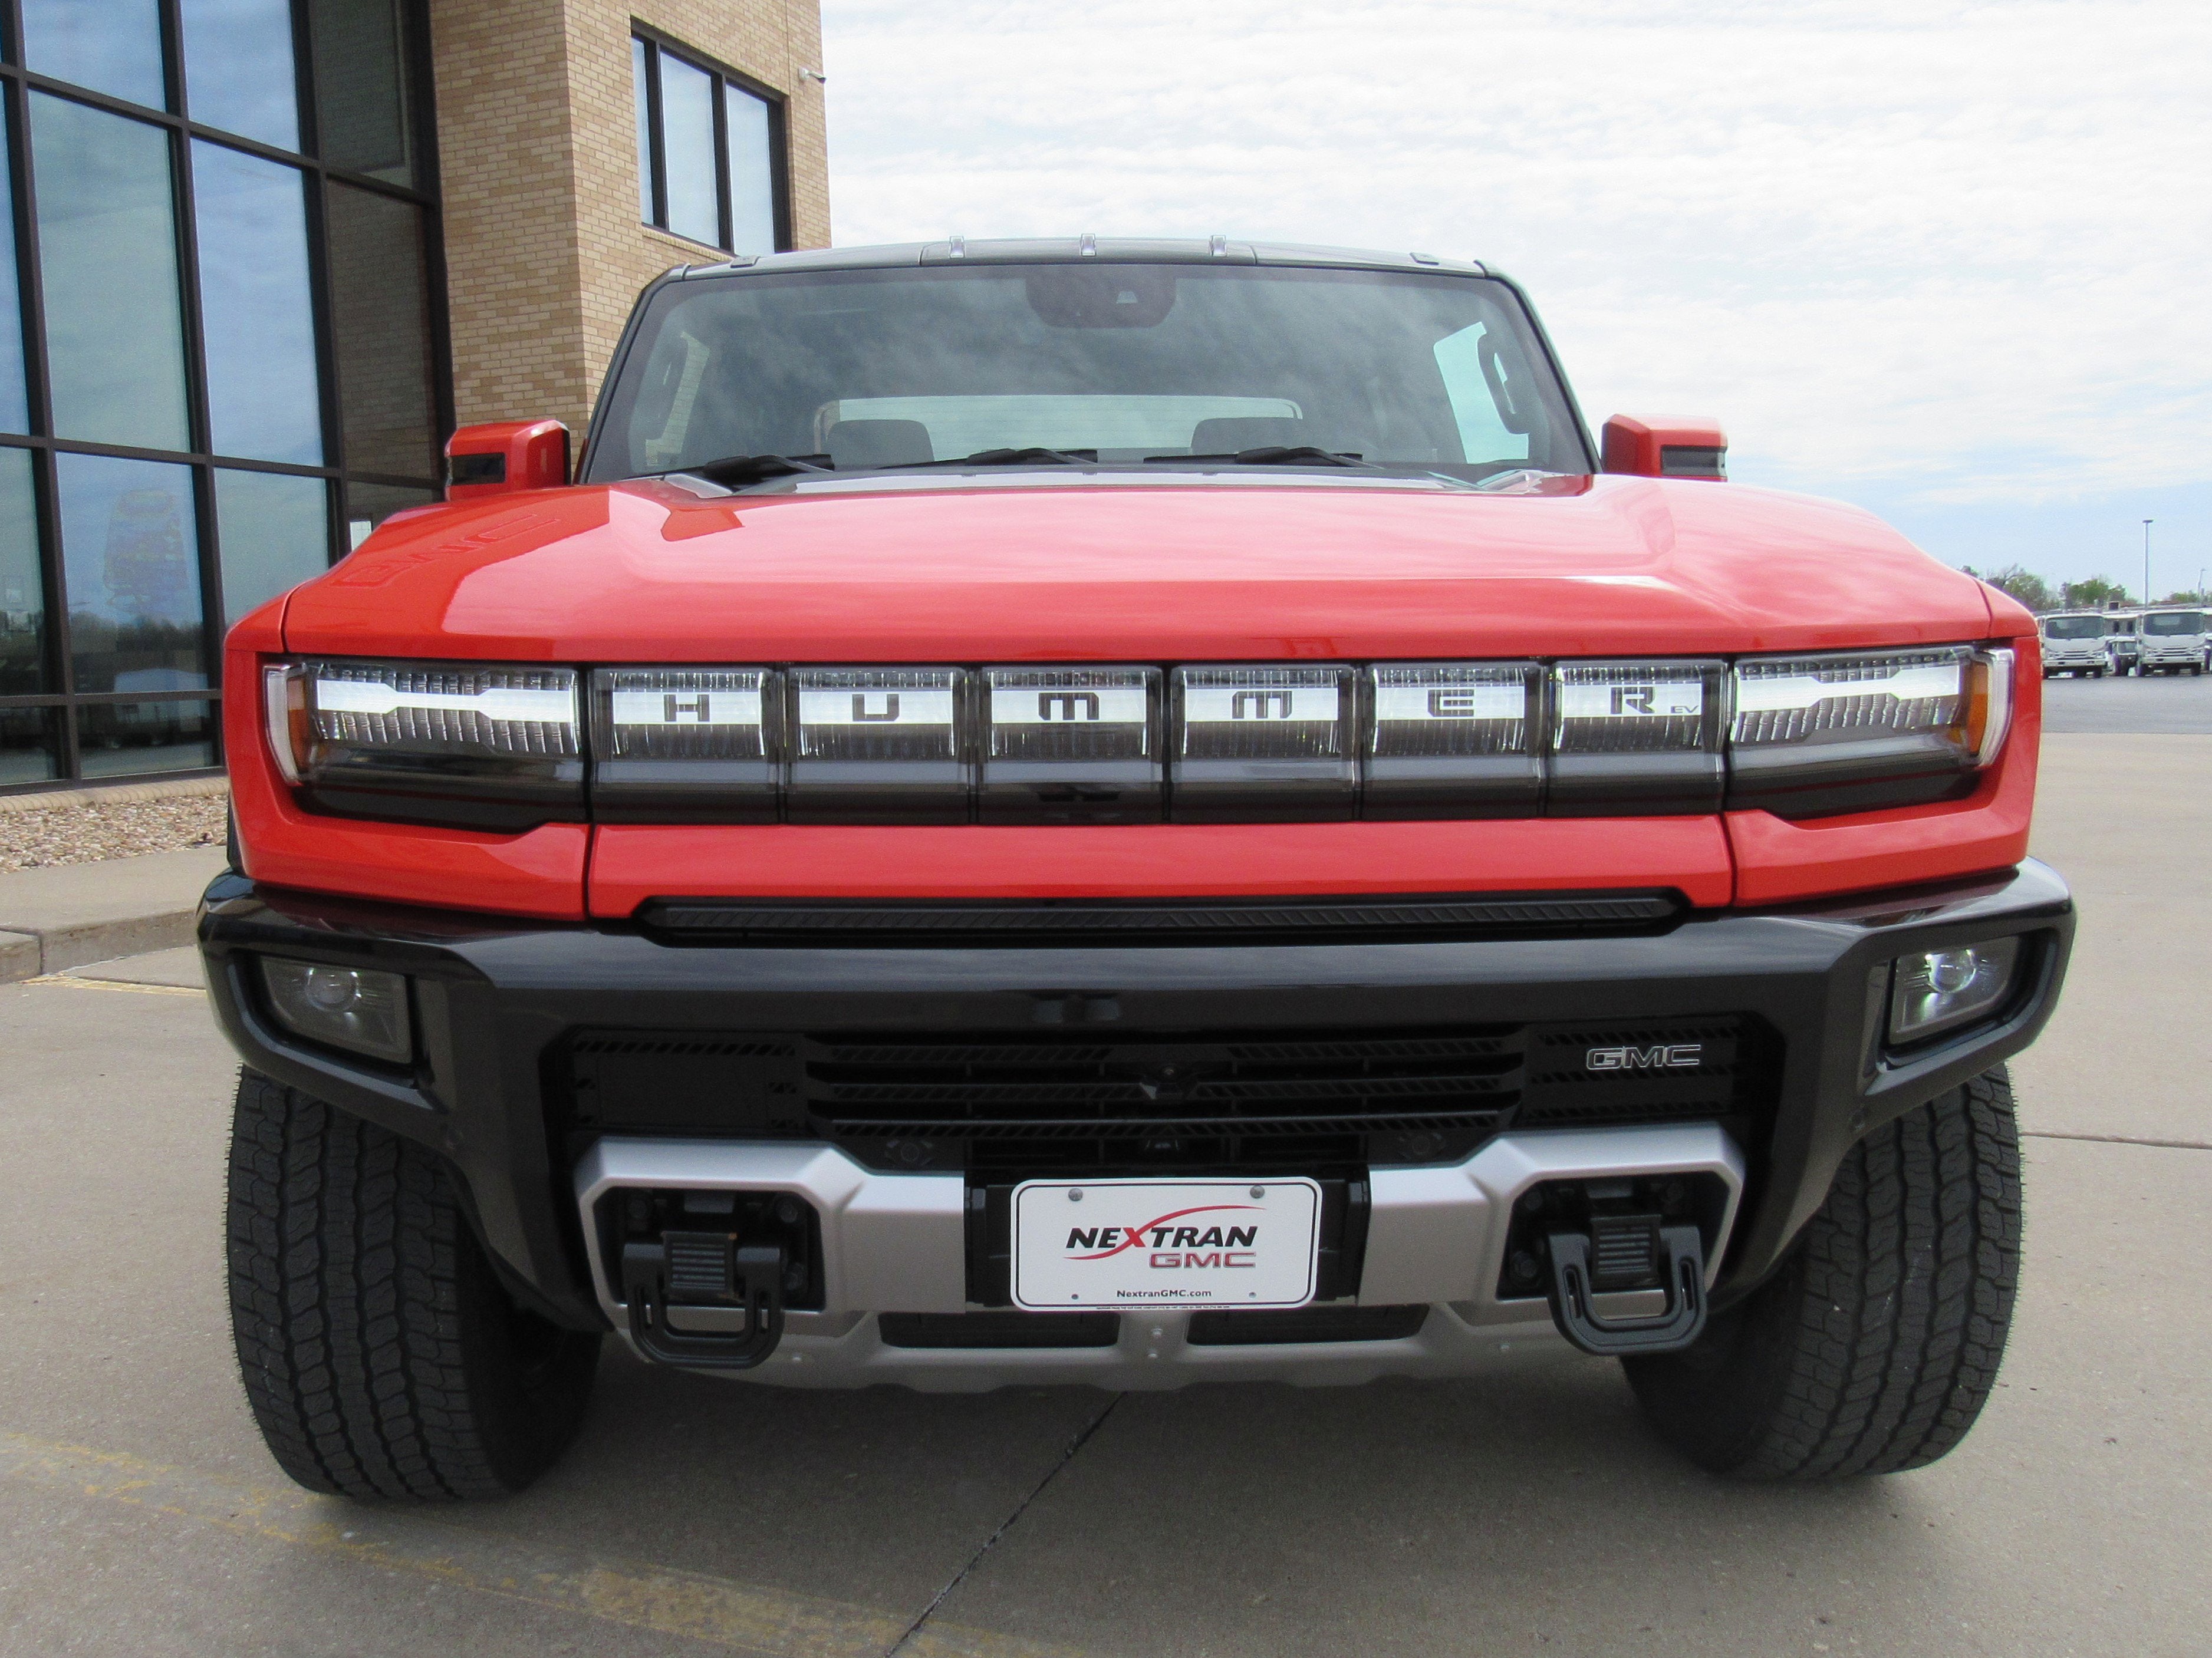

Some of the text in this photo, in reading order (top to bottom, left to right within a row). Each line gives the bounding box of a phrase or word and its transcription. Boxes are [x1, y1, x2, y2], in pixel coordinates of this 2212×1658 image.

[663, 686, 1699, 723] HUMMER EV
[1586, 1044, 1701, 1070] GMC
[1065, 1225, 1258, 1249] NEXTRAN
[1148, 1251, 1257, 1269] GMC
[1116, 1289, 1212, 1299] NextranGMC.com
